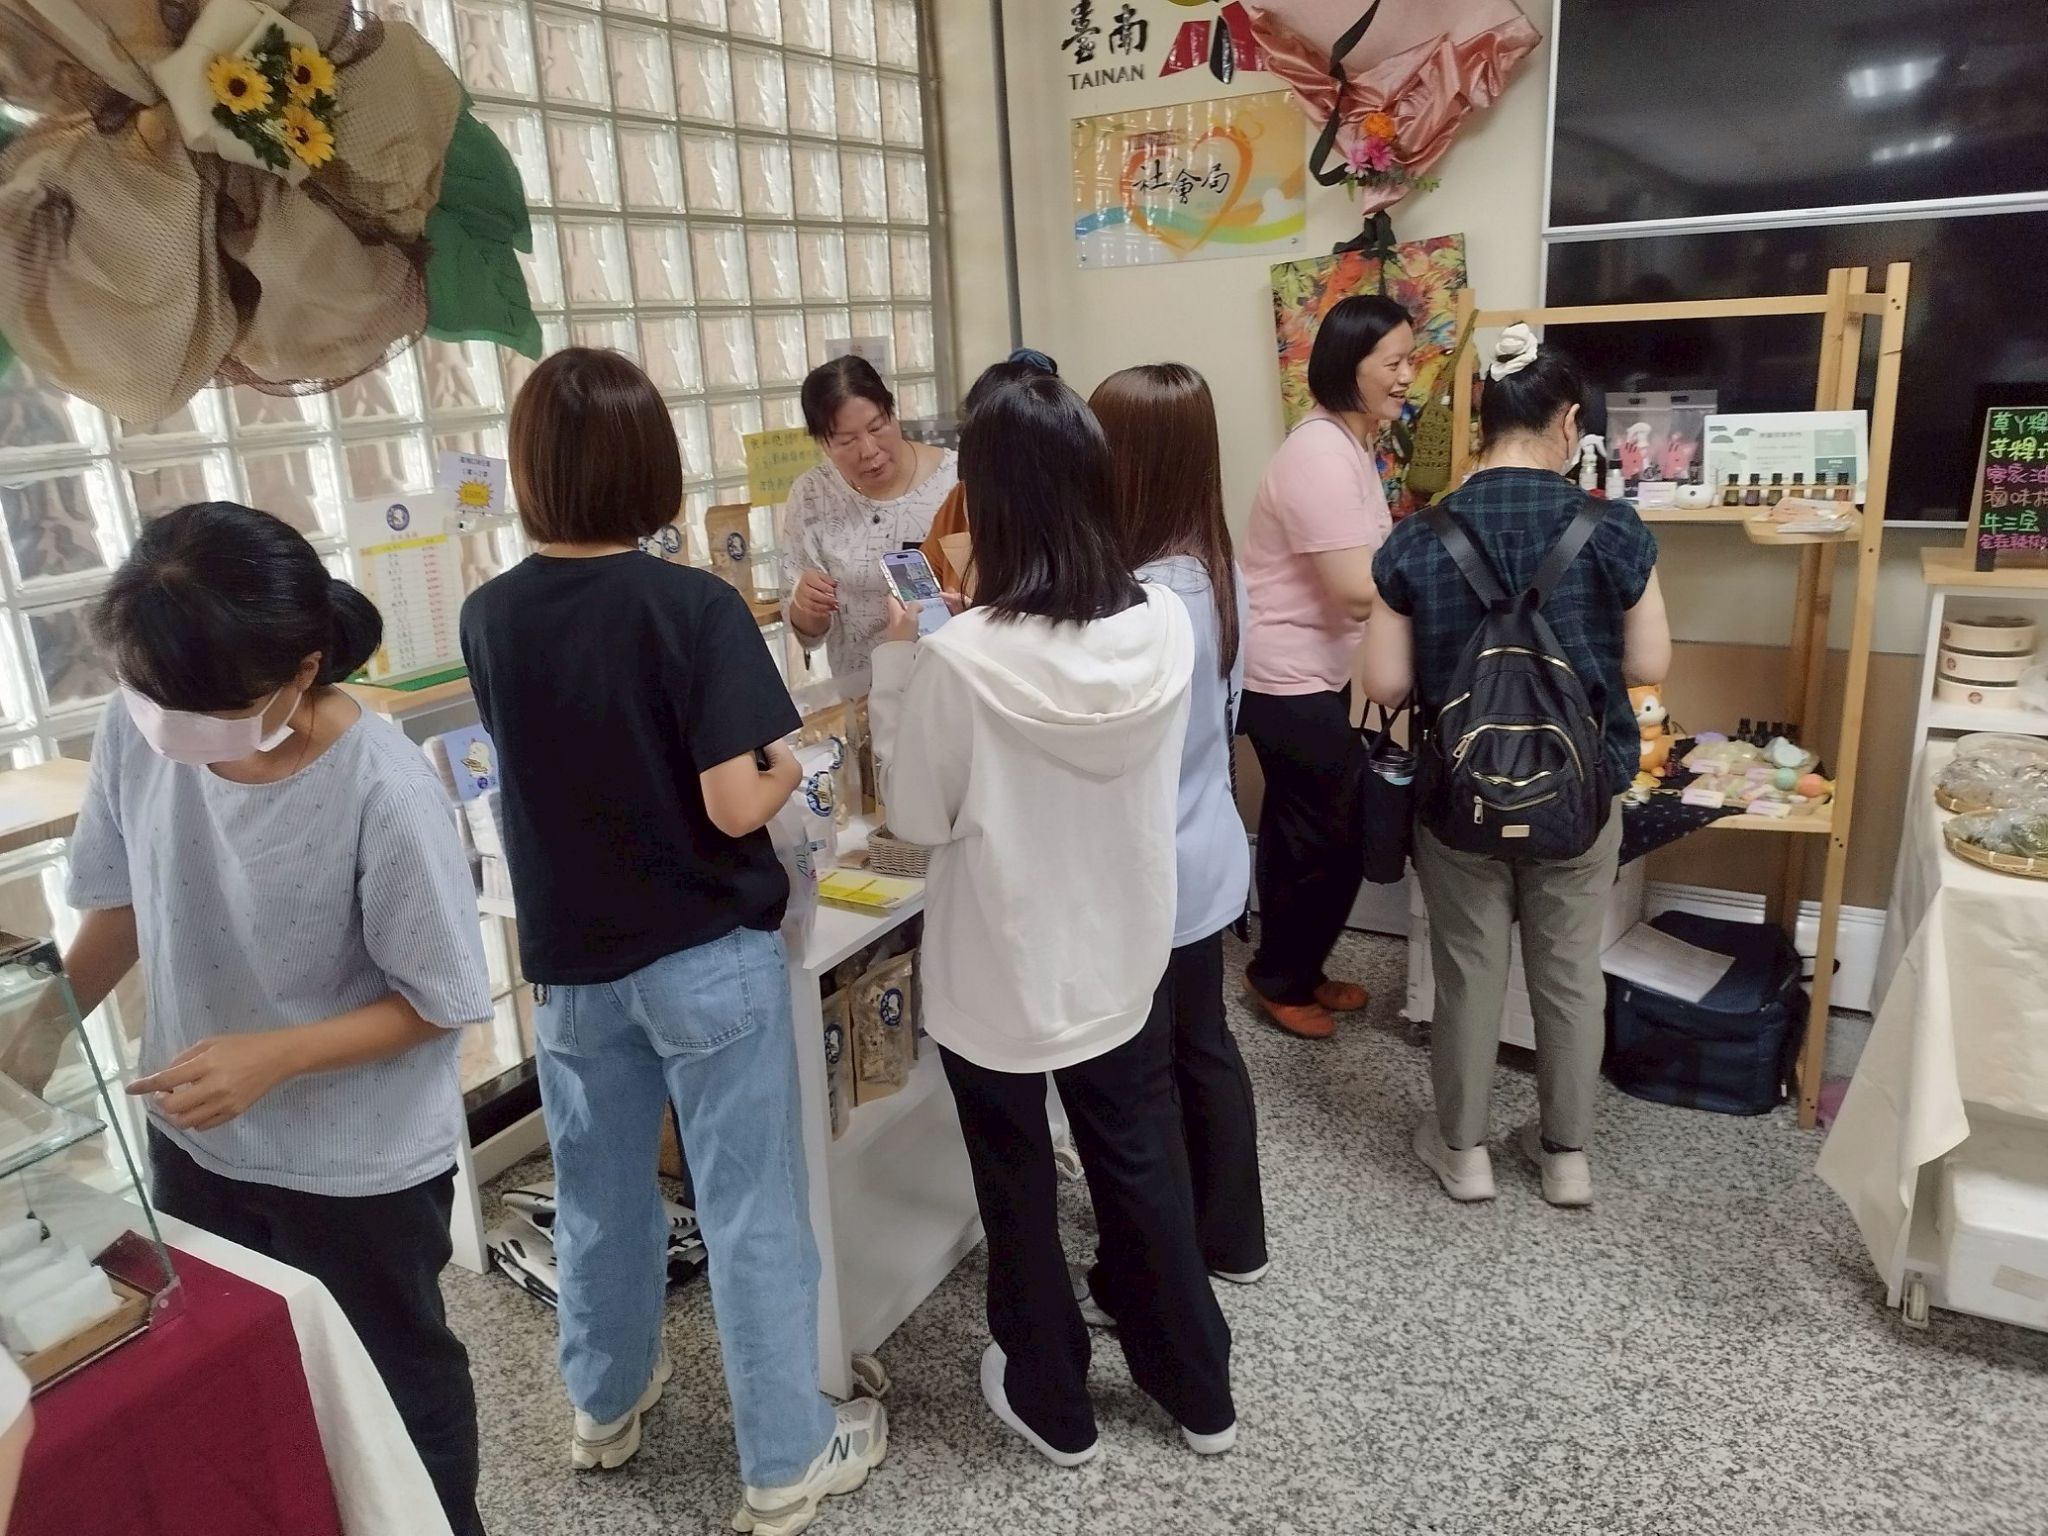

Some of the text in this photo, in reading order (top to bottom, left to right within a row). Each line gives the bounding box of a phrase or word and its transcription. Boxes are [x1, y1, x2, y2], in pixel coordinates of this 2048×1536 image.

[1061, 0, 1148, 64] 臺南
[1068, 64, 1145, 91] TAINAN
[1132, 158, 1230, 204] 社會局
[828, 1433, 850, 1464] N
